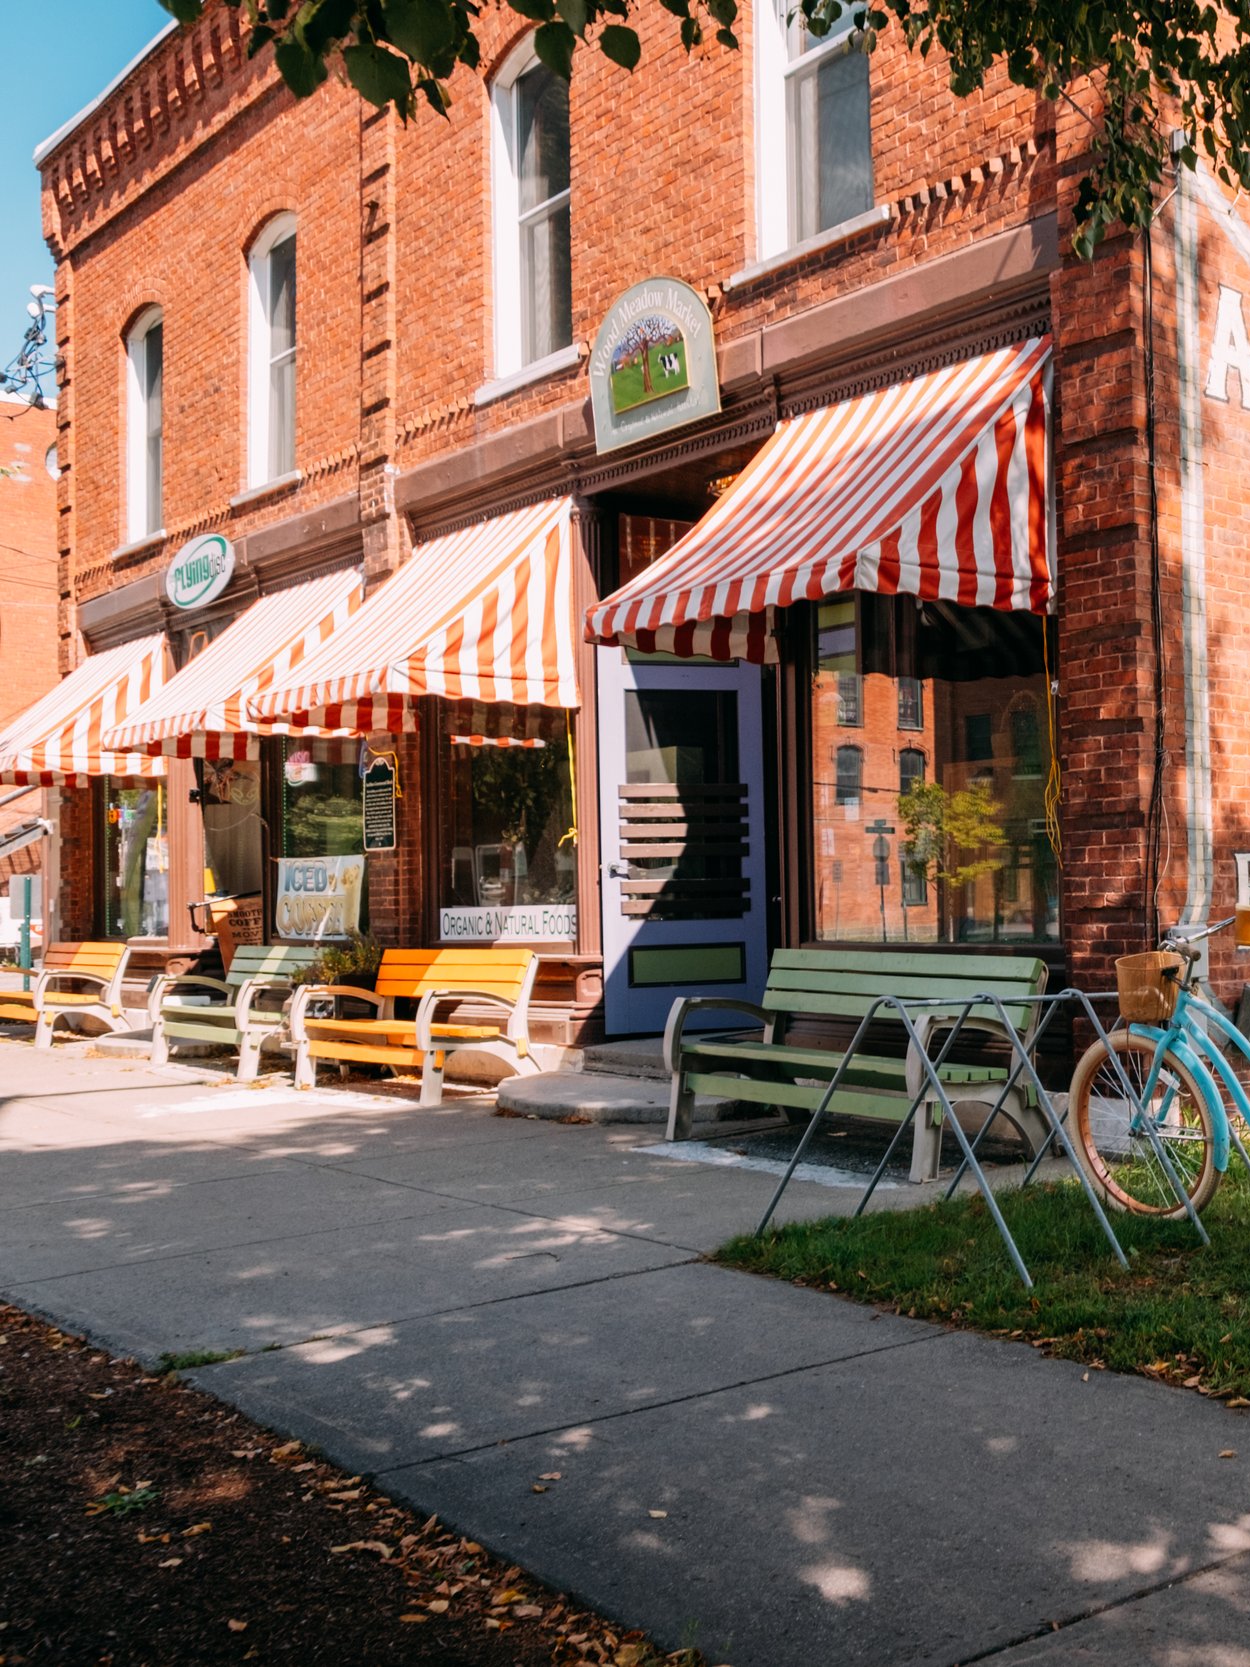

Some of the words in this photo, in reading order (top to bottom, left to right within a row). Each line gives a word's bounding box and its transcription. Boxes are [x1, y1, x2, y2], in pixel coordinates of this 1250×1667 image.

[593, 321, 620, 378] Wood
[618, 286, 663, 328] Meadow
[665, 287, 702, 338] Market
[284, 860, 327, 893] ICED
[442, 912, 483, 936] ORGANIC
[485, 912, 493, 935] &
[495, 911, 540, 935] NATURAL
[543, 910, 577, 935] FOODS
